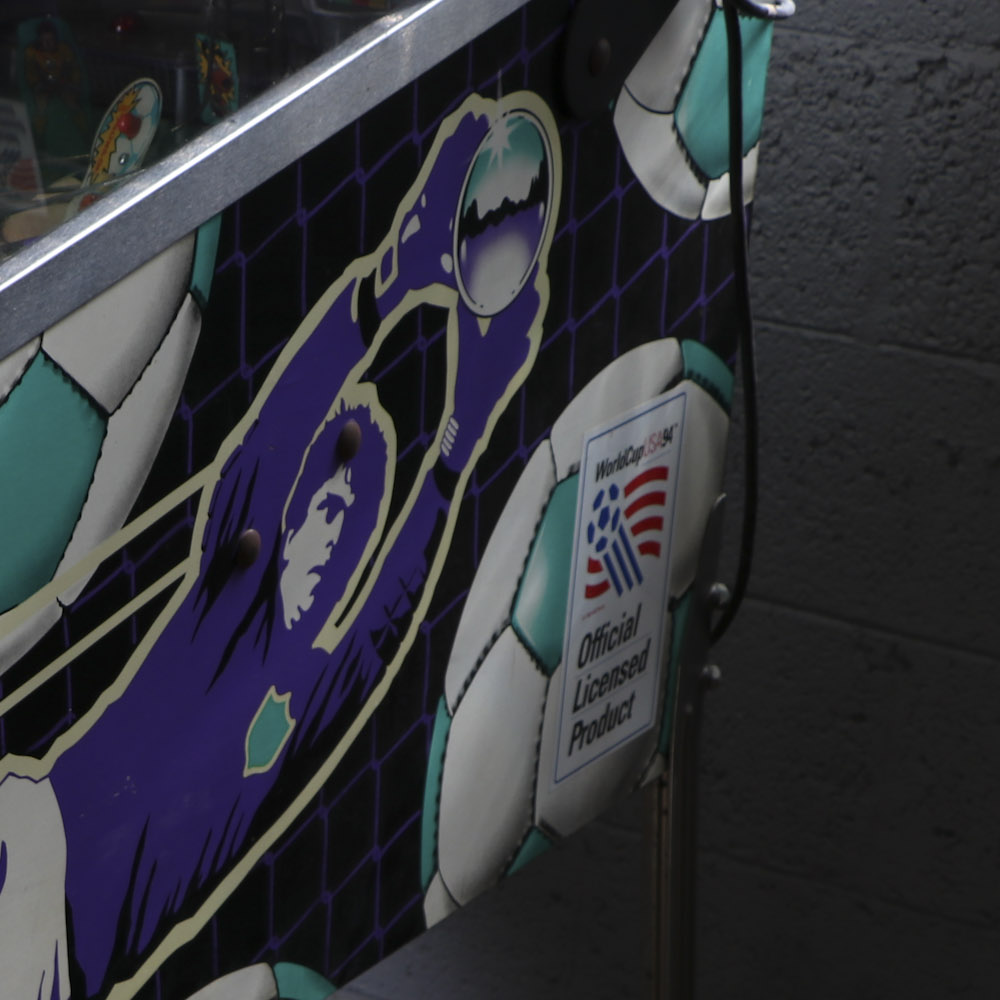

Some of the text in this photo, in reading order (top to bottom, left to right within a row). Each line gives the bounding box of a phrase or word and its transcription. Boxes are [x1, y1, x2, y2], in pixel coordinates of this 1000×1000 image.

[577, 602, 643, 670] Official
[572, 637, 652, 715] Licensed
[567, 690, 637, 758] Product
